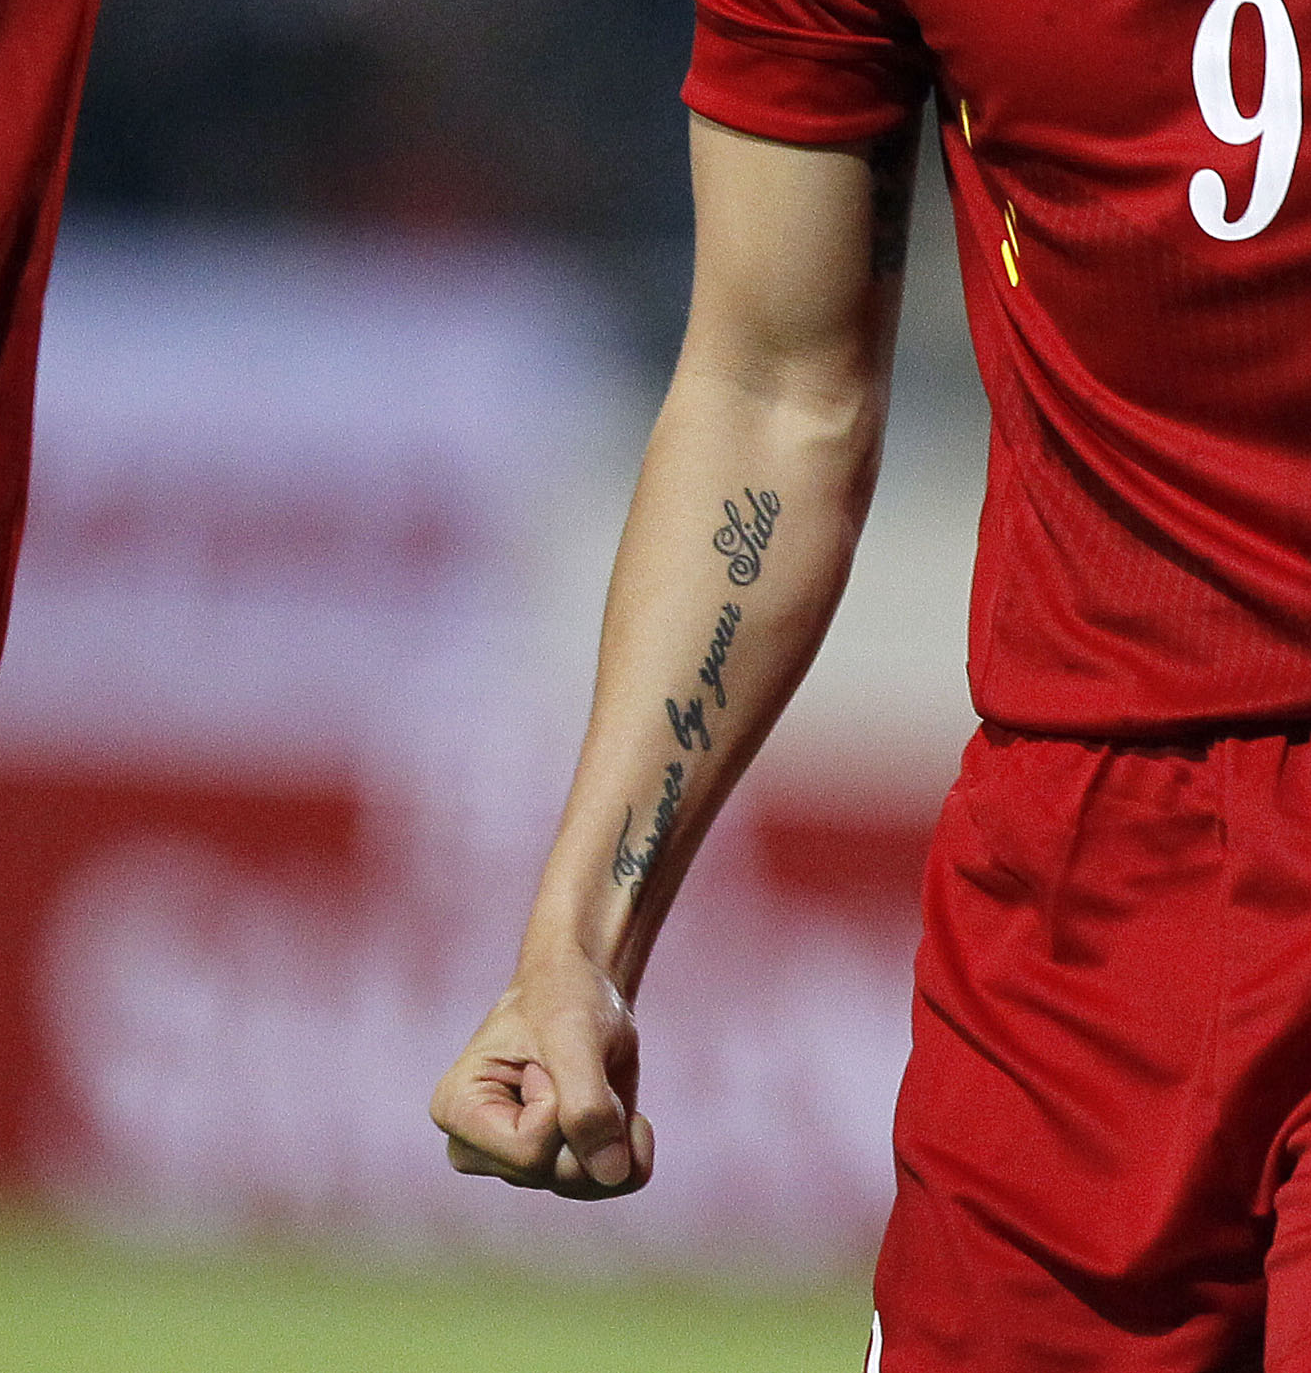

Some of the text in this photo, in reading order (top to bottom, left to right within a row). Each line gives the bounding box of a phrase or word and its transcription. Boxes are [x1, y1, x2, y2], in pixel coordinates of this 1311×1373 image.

[713, 487, 781, 586] Side
[699, 601, 741, 708] your
[665, 697, 711, 752] by
